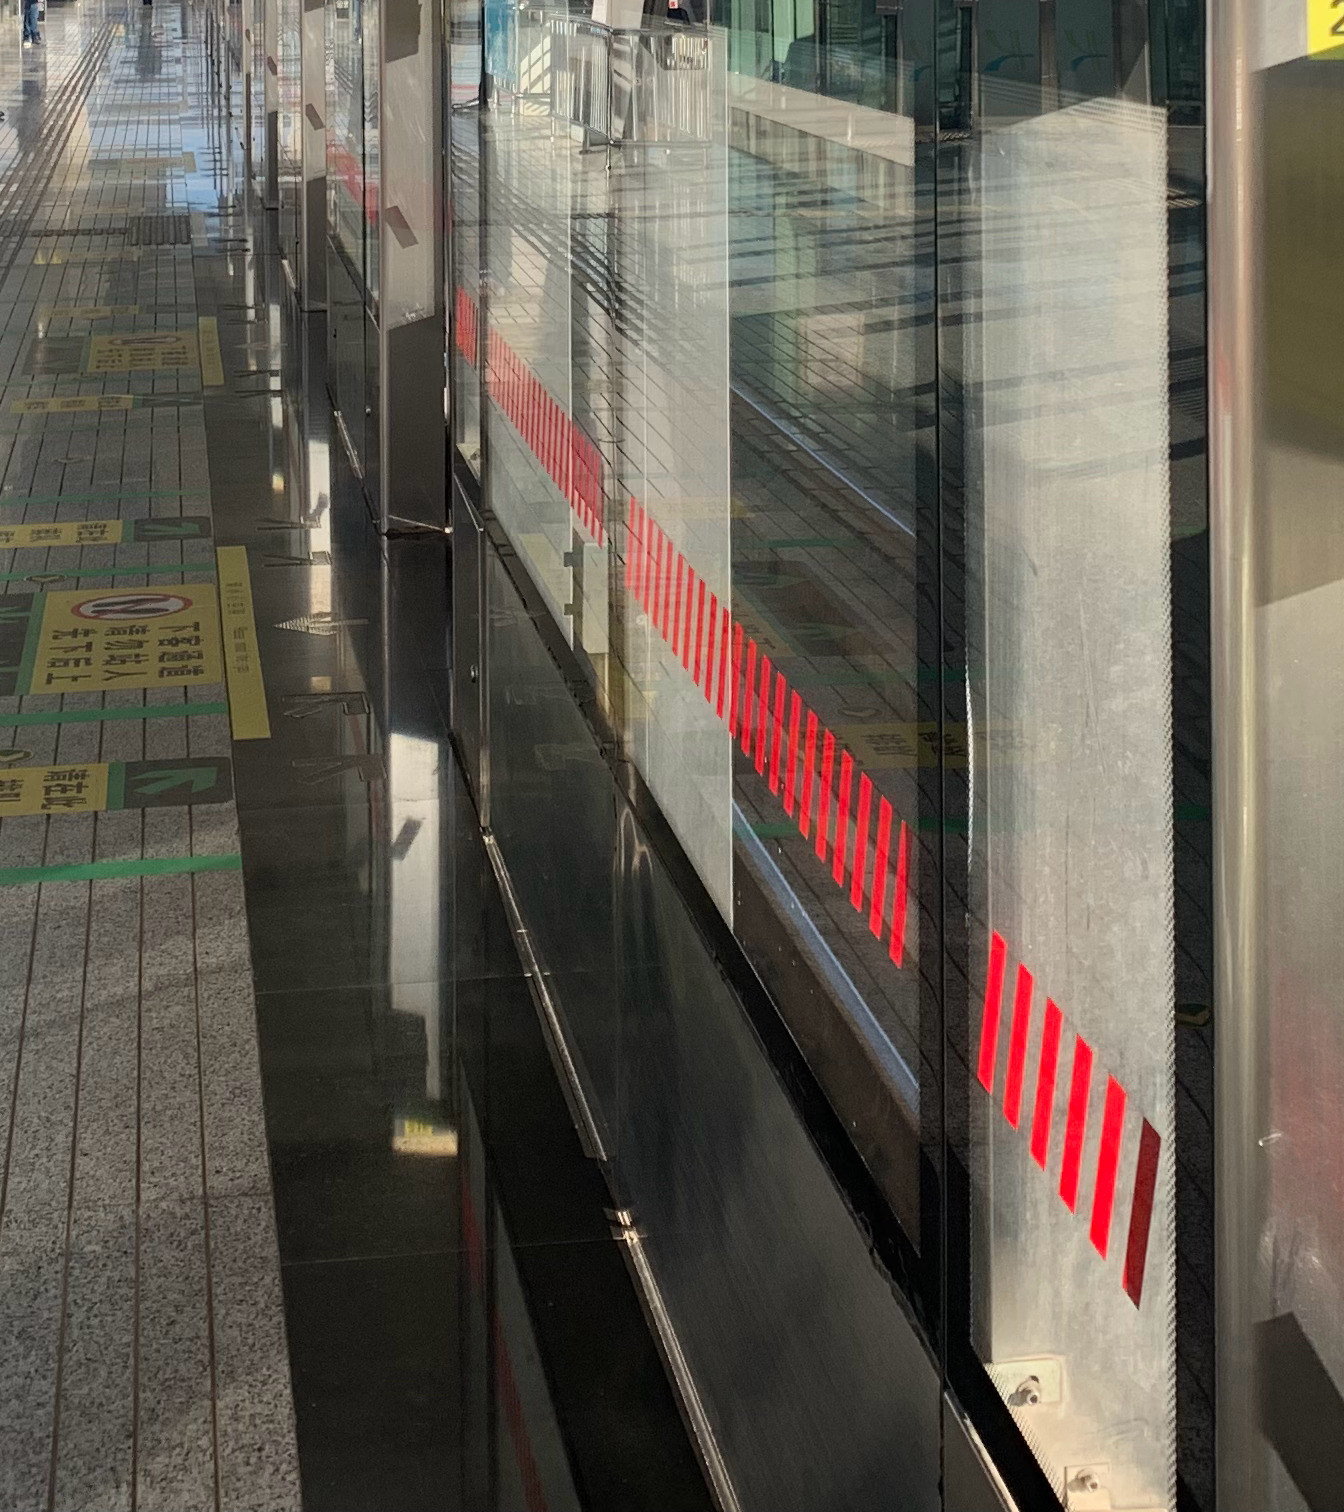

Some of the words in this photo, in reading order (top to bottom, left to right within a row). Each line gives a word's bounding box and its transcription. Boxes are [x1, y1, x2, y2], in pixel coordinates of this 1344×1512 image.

[45, 628, 98, 686] 先下后上
[103, 624, 151, 682] 请勿站人
[158, 621, 205, 679] 下客通道
[41, 768, 89, 810] 请在此
